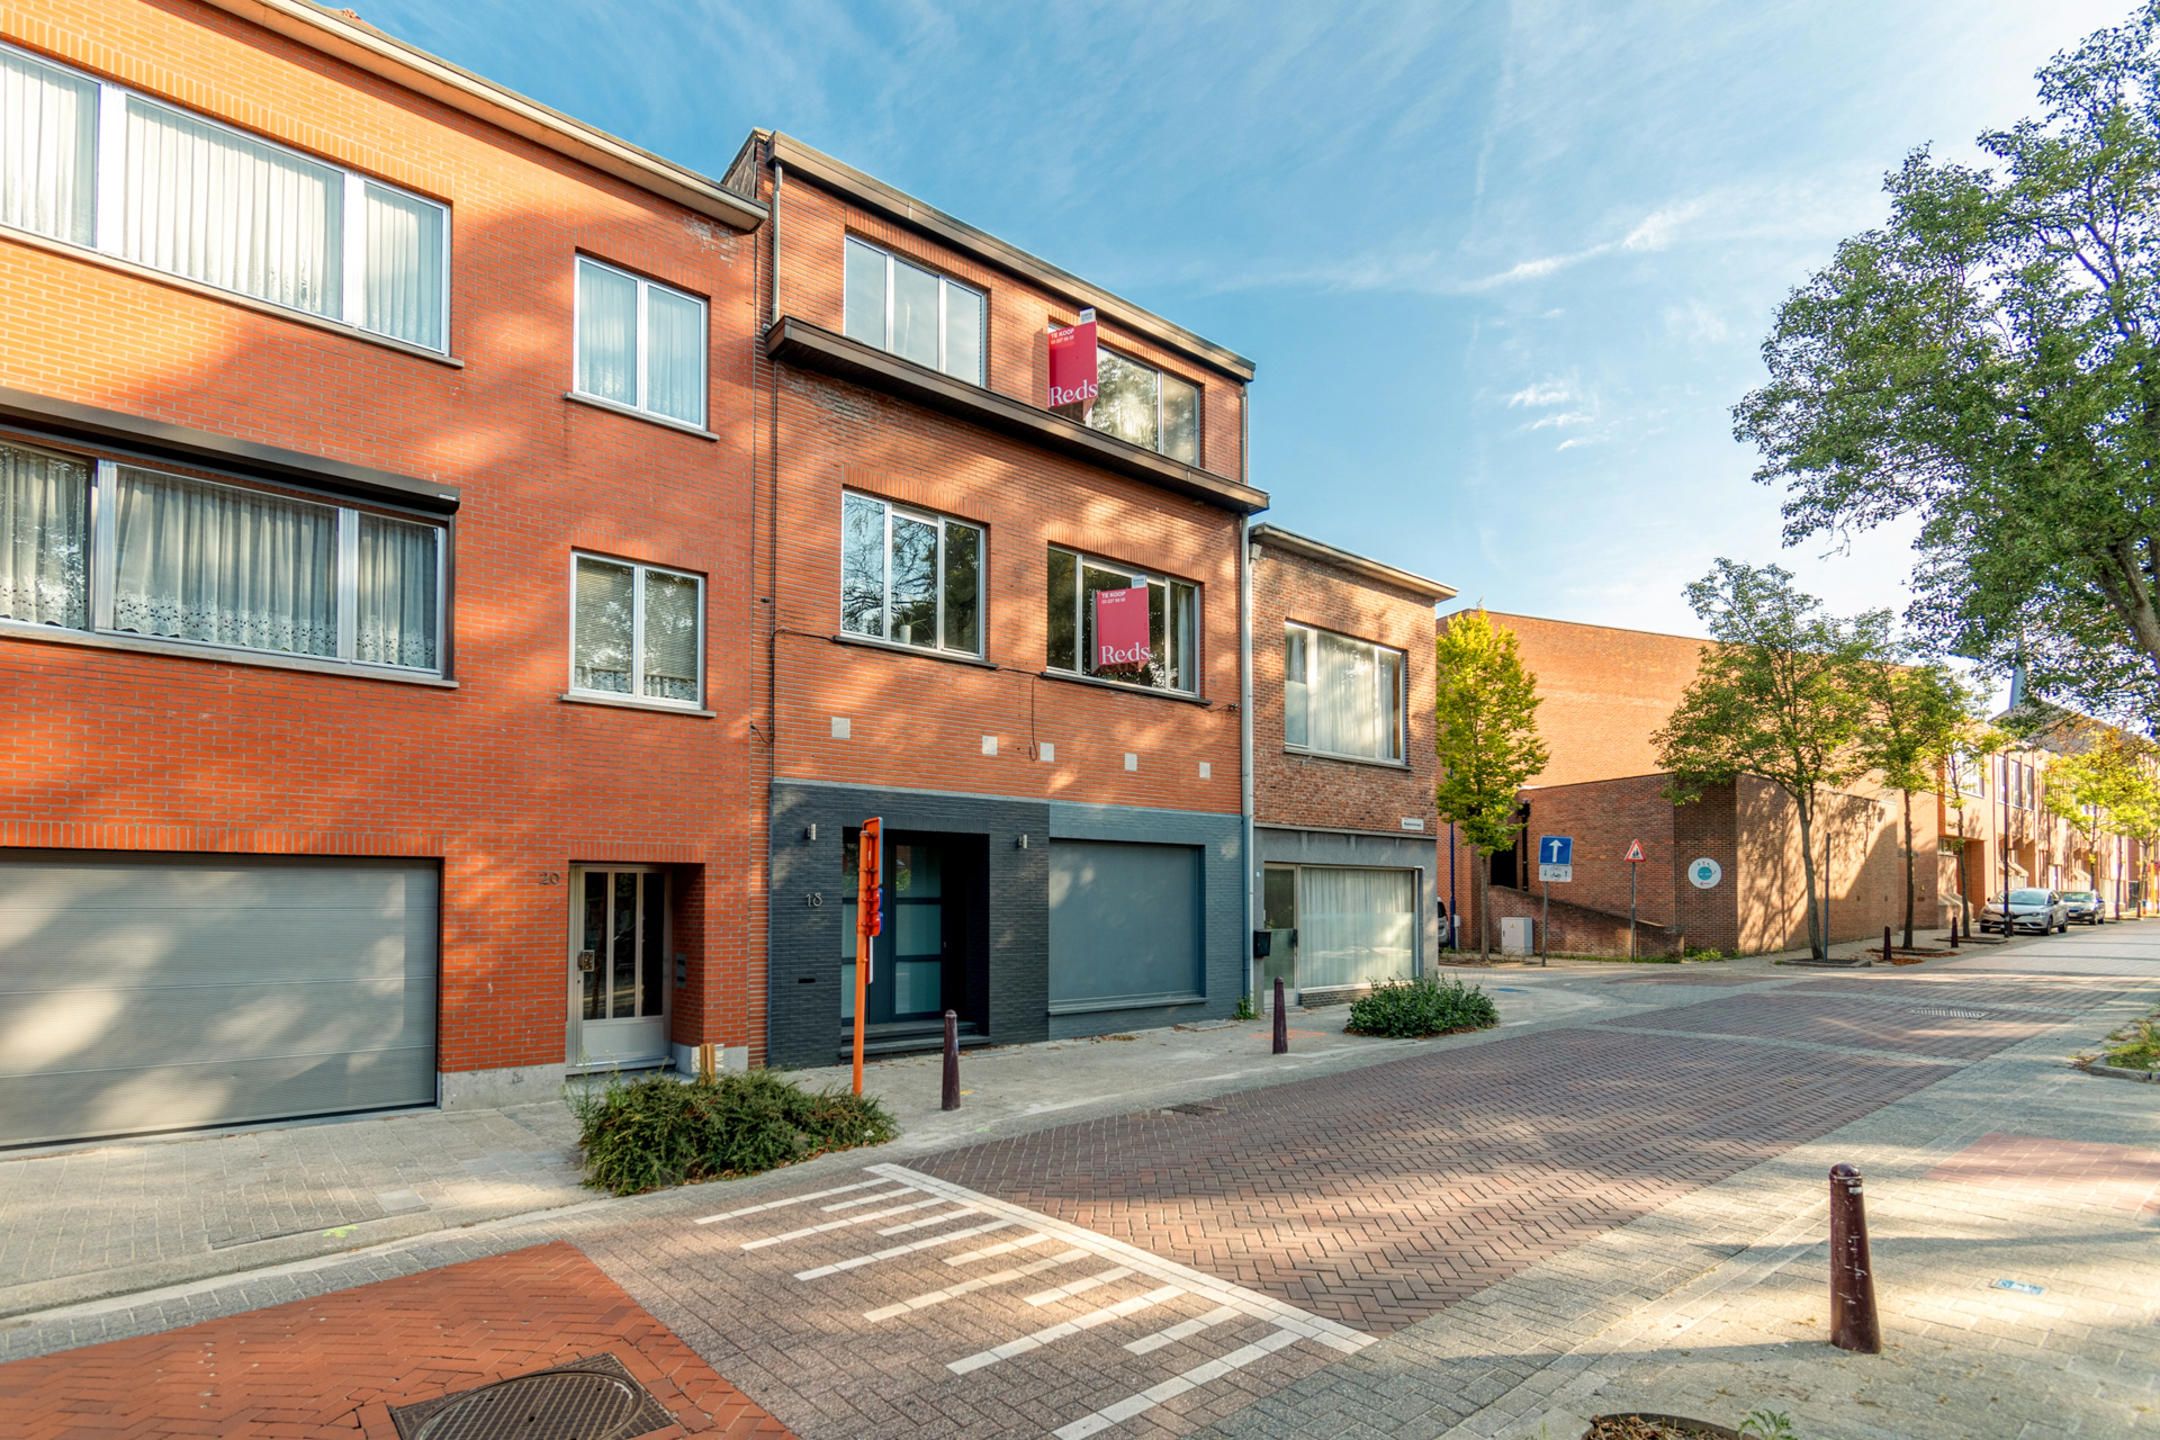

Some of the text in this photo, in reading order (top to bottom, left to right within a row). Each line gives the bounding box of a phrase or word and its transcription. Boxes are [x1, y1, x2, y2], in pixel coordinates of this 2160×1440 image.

[1059, 328, 1074, 337] KOOP
[1050, 379, 1098, 407] Reds
[1101, 642, 1150, 665] Reds
[539, 872, 560, 886] 20
[806, 892, 823, 907] 18
